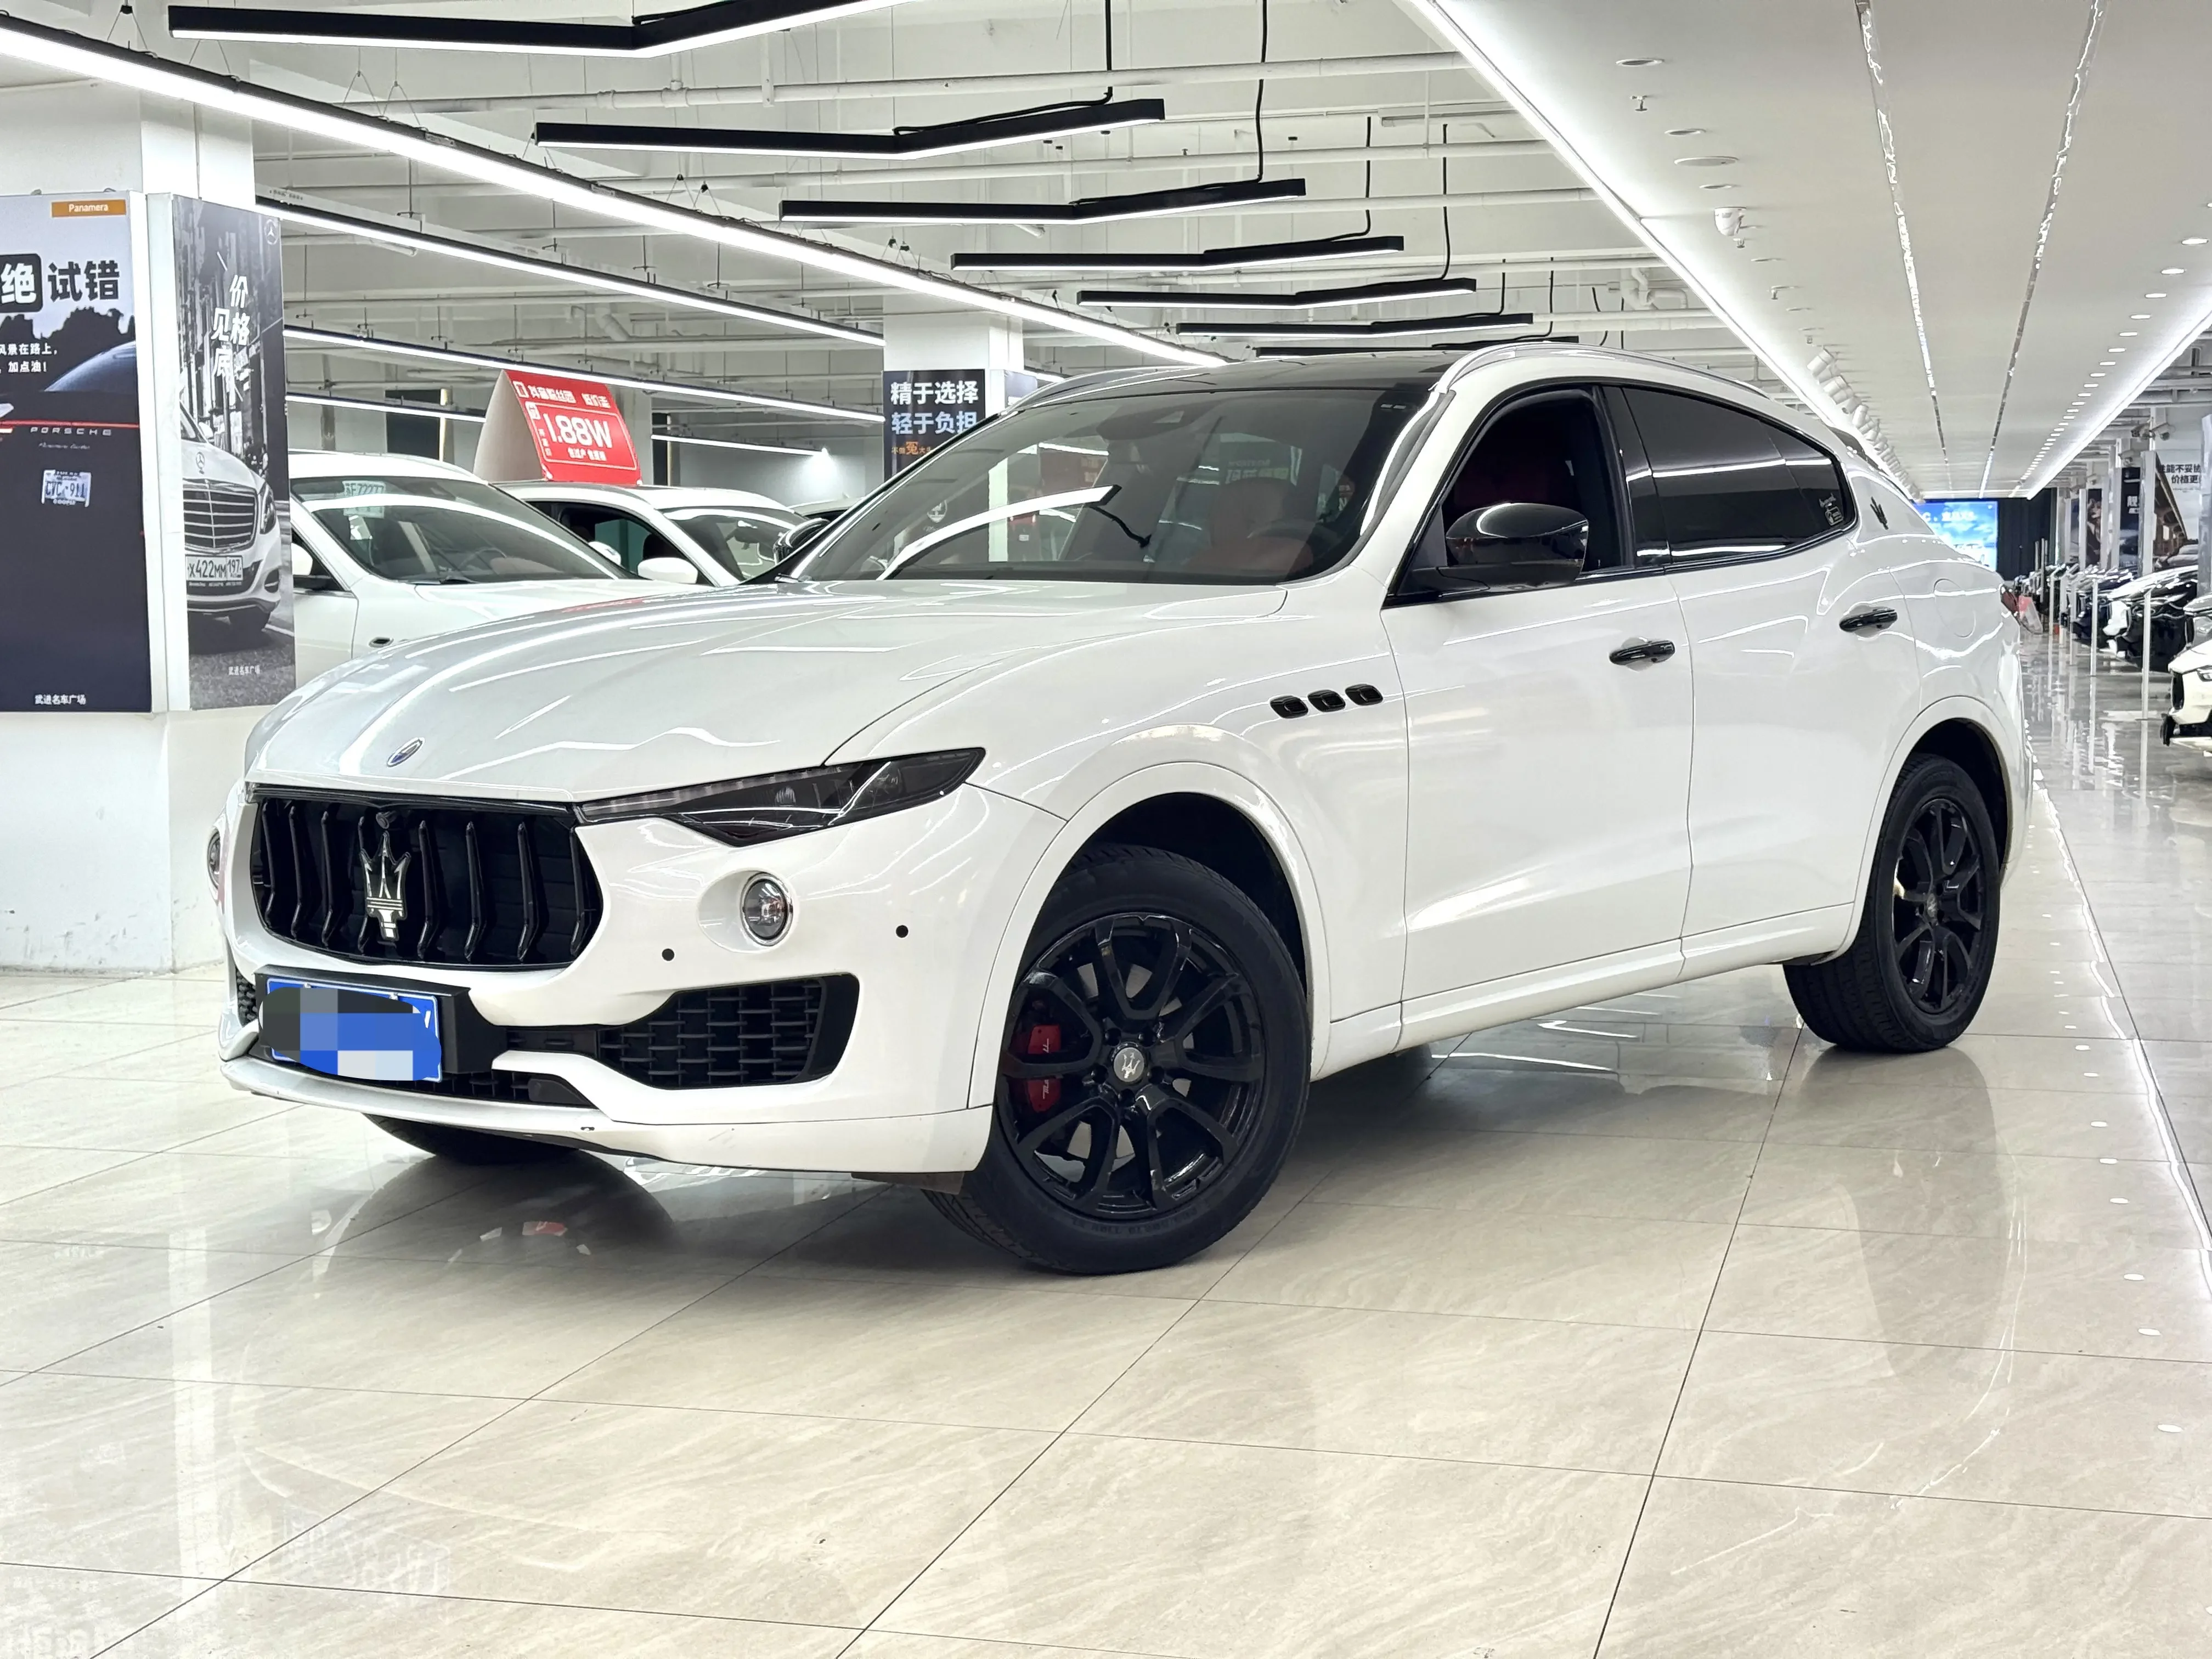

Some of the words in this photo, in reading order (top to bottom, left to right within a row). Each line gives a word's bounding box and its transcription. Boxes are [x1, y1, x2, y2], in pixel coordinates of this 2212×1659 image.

[69, 204, 109, 213] Panamera
[890, 380, 979, 405] 精于选择
[30, 426, 112, 436] PORSCHE
[542, 413, 613, 448] 1.88W
[891, 410, 978, 435] 轻于负担
